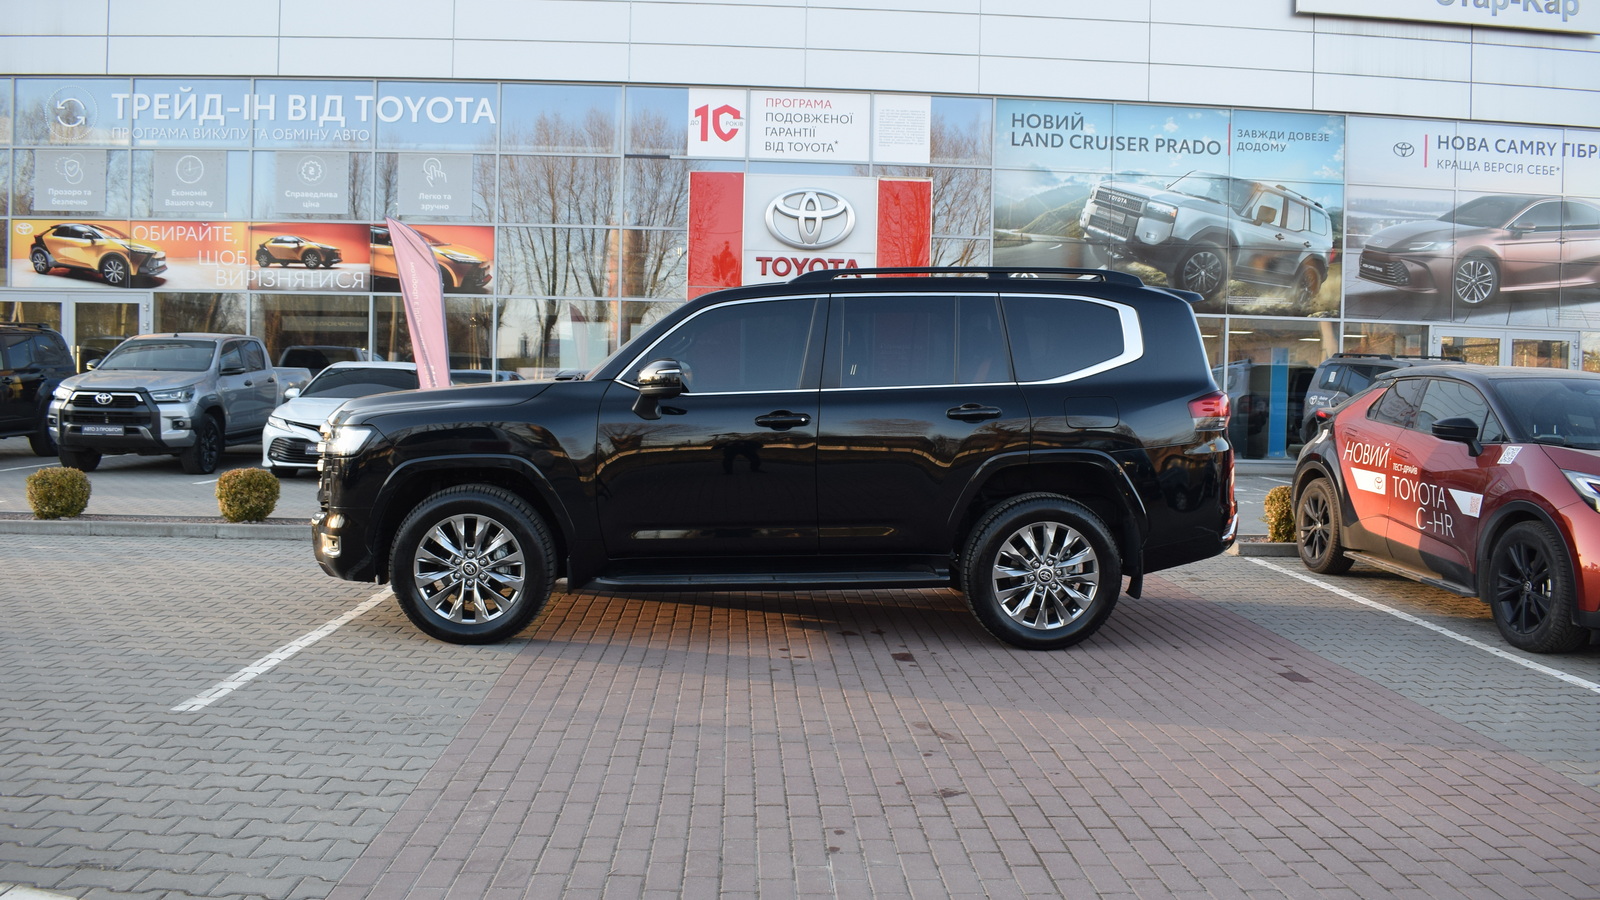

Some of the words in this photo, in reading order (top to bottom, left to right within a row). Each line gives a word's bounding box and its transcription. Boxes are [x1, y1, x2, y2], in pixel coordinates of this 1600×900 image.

[111, 86, 275, 126] ТРЕЙД-ІН
[288, 94, 346, 128] ВІД
[355, 95, 496, 124] TOYOTA
[765, 97, 833, 109] ПРОГРАМА
[765, 112, 854, 125] ПОДОВЖЕНОЇ
[1011, 111, 1084, 131] НОВИЙ
[112, 127, 189, 139] ПРОГРАМА
[193, 128, 248, 140] ВИКУПУ
[252, 128, 269, 140] ТА
[273, 128, 328, 140] ОБМІНУ
[332, 129, 370, 141] АВТО
[765, 126, 816, 138] ГАРАНТІЇ
[1237, 129, 1285, 141] ЗАВЖДИ
[1288, 131, 1330, 142] ДОВЕЗЕ
[765, 141, 784, 153] ВІД
[1011, 131, 1064, 148] LAND
[1069, 134, 1150, 153] CRUISER
[1155, 139, 1222, 156] PRADO
[1236, 142, 1287, 152] ДОДОМУ
[1437, 135, 1489, 152] НОВА
[1494, 138, 1557, 156] CAMRY
[1562, 142, 1600, 159] ГІБР
[1436, 159, 1480, 172] КРАЩА
[1484, 162, 1523, 174] ВЕРСІЯ
[48, 188, 82, 197] Прозоро
[171, 189, 207, 197] Економія
[284, 190, 338, 199] Справедлива
[418, 193, 441, 201] Легко
[1108, 194, 1128, 204] TOYOTA
[51, 198, 88, 206] безпечно
[196, 200, 213, 208] часу
[302, 201, 320, 209] ціна
[420, 203, 449, 211] зручно
[132, 222, 238, 244] ОБИРАЙТЕ,
[198, 249, 248, 267] ЩОБ
[756, 256, 862, 278] TOYOTA
[215, 269, 364, 289] ВИРІЗНЯТИСЯ
[1342, 441, 1391, 469] НОВИЙ
[1392, 462, 1418, 475] ТЕСТ-ДРАЙВ
[1392, 475, 1448, 511] TOYOTA
[1415, 507, 1455, 538] C-HR
